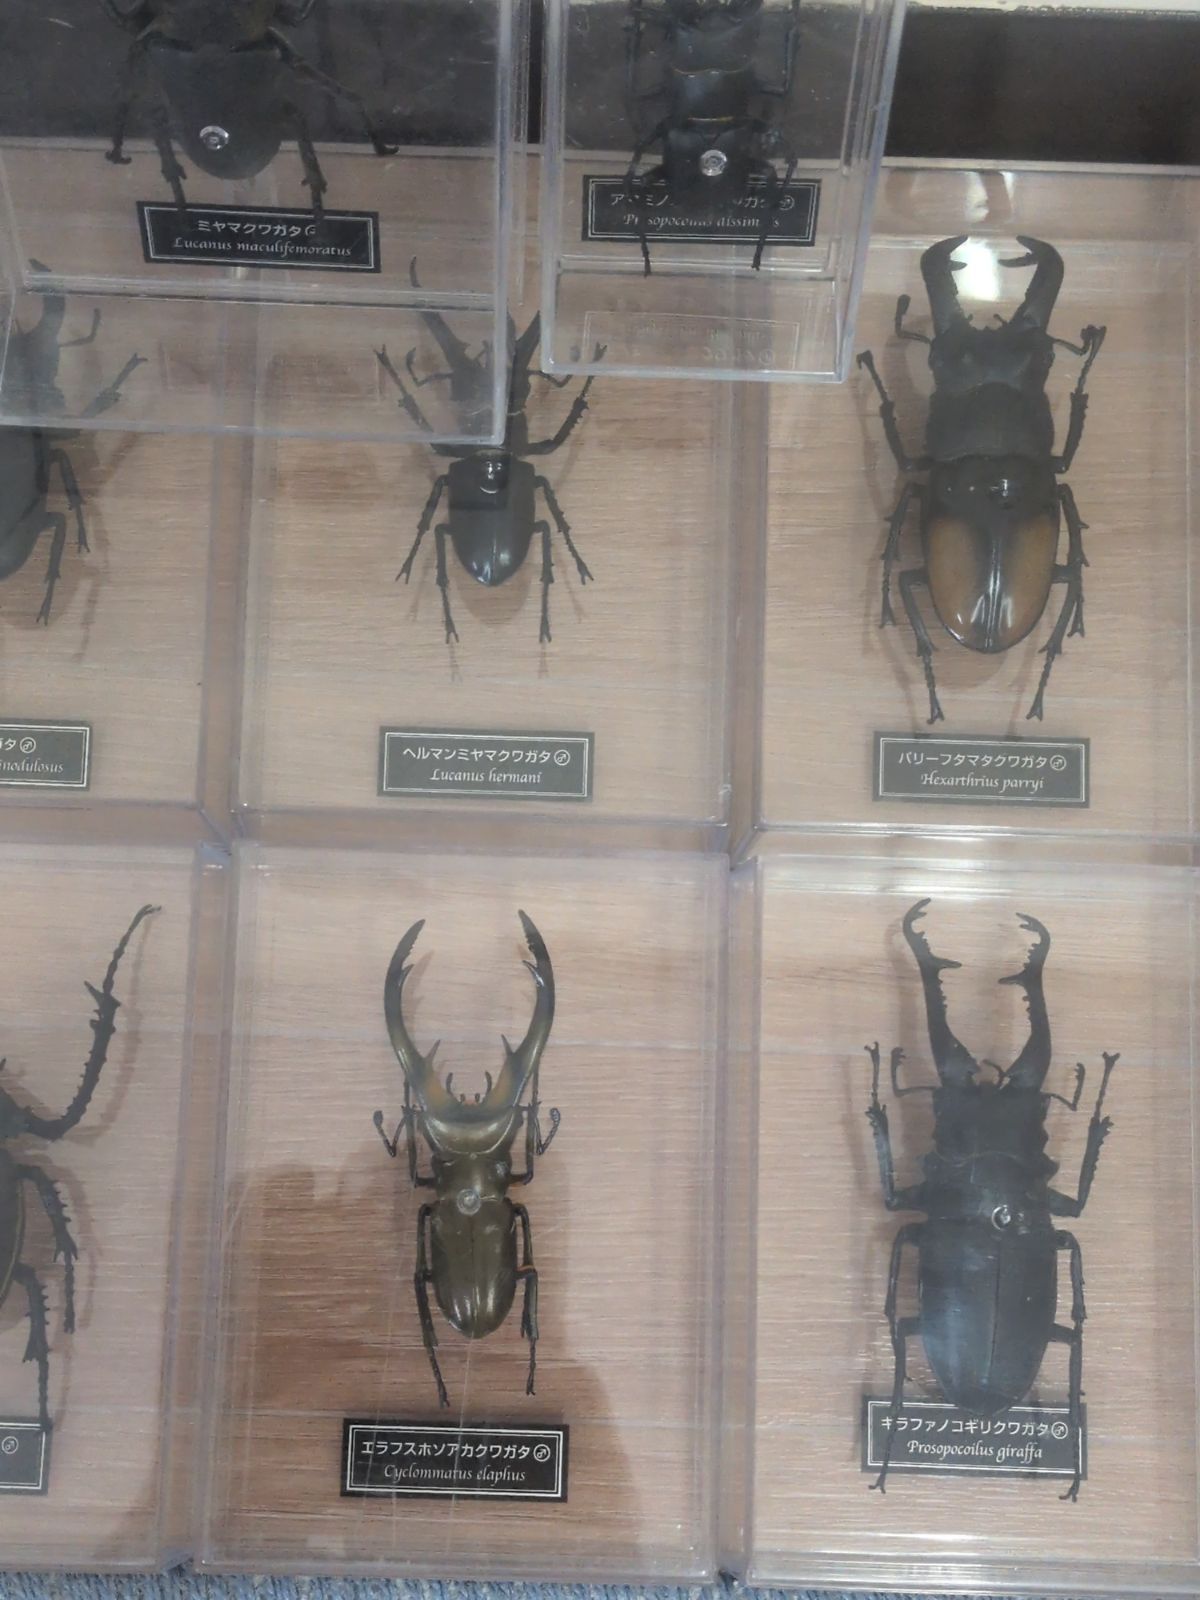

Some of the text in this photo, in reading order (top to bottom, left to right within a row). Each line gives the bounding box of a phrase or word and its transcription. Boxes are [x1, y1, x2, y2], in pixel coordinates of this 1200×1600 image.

[198, 220, 301, 237] ミヤマクワガタ
[716, 216, 779, 228] dissims
[174, 237, 351, 257] Lucanus maculifemoratus
[403, 747, 551, 763] ヘルマンミヤマクワガタ
[430, 768, 542, 783] Lucanus hermani
[921, 770, 1044, 793] Hexarthrius parryi
[361, 1441, 530, 1459] エラフスホソアカクワガタ
[907, 1440, 1043, 1463] Prosopocoilus giraffa
[384, 1462, 526, 1486] Cyclommatus elaphus
